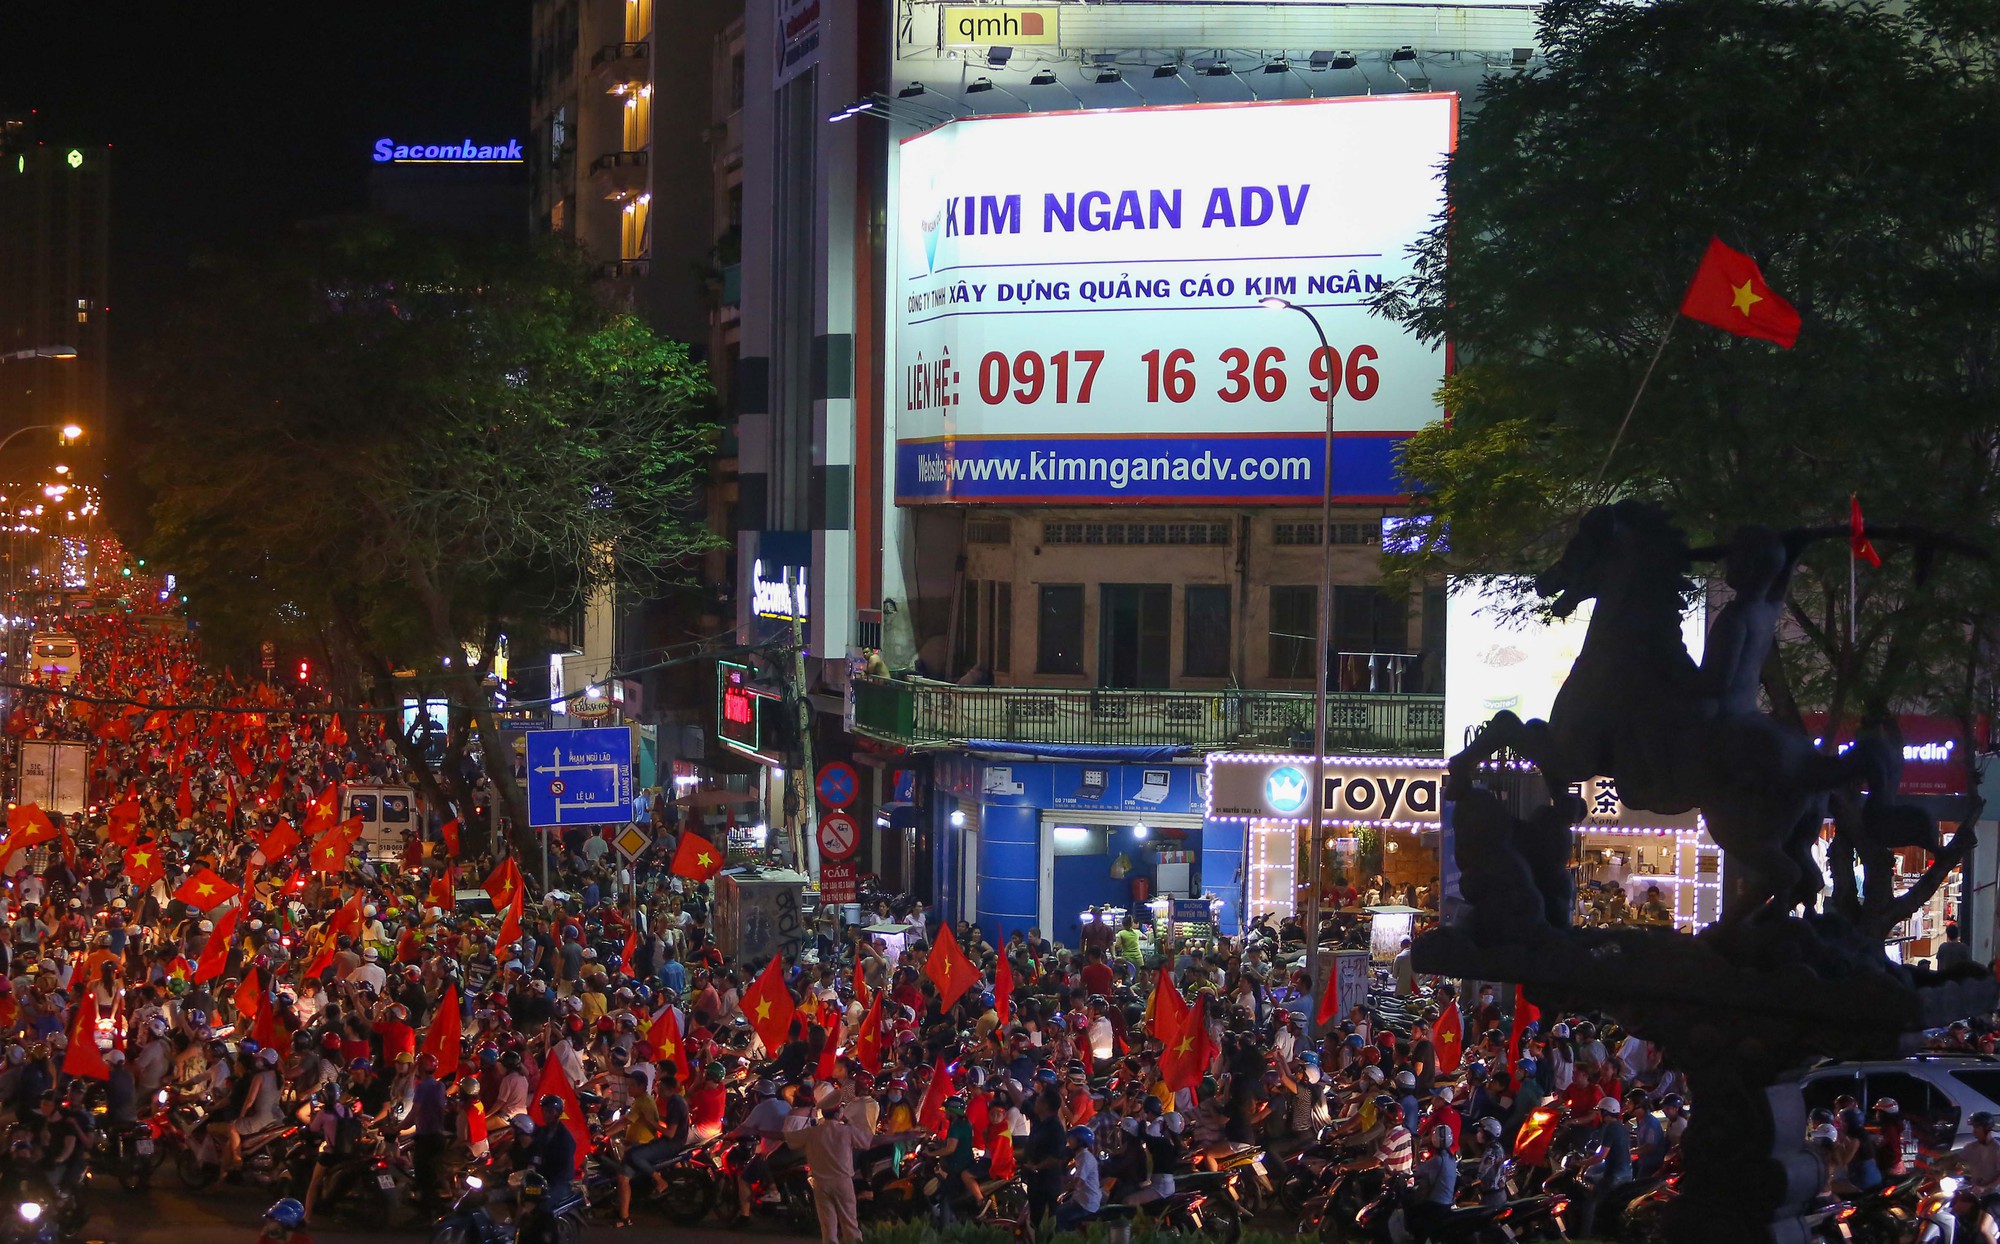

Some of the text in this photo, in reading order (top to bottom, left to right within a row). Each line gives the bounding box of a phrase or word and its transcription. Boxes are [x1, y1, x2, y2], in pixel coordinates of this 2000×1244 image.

[960, 13, 1018, 41] qmh
[373, 138, 523, 162] Sacombank
[946, 184, 1311, 238] KIM NGAN ADV
[908, 269, 1382, 313] CÔNG TY TNHH XÂY DỰNG QUẢNG CÁO KIM NGÂN
[907, 344, 1379, 416] LIÊN HỆ: 0917 16 36 96
[951, 450, 1311, 488] www.kimnganadv.com
[569, 754, 585, 765] PHẠM
[599, 752, 611, 761] LÃO
[576, 791, 595, 800] LÊ LAI
[827, 866, 849, 877] CẤM
